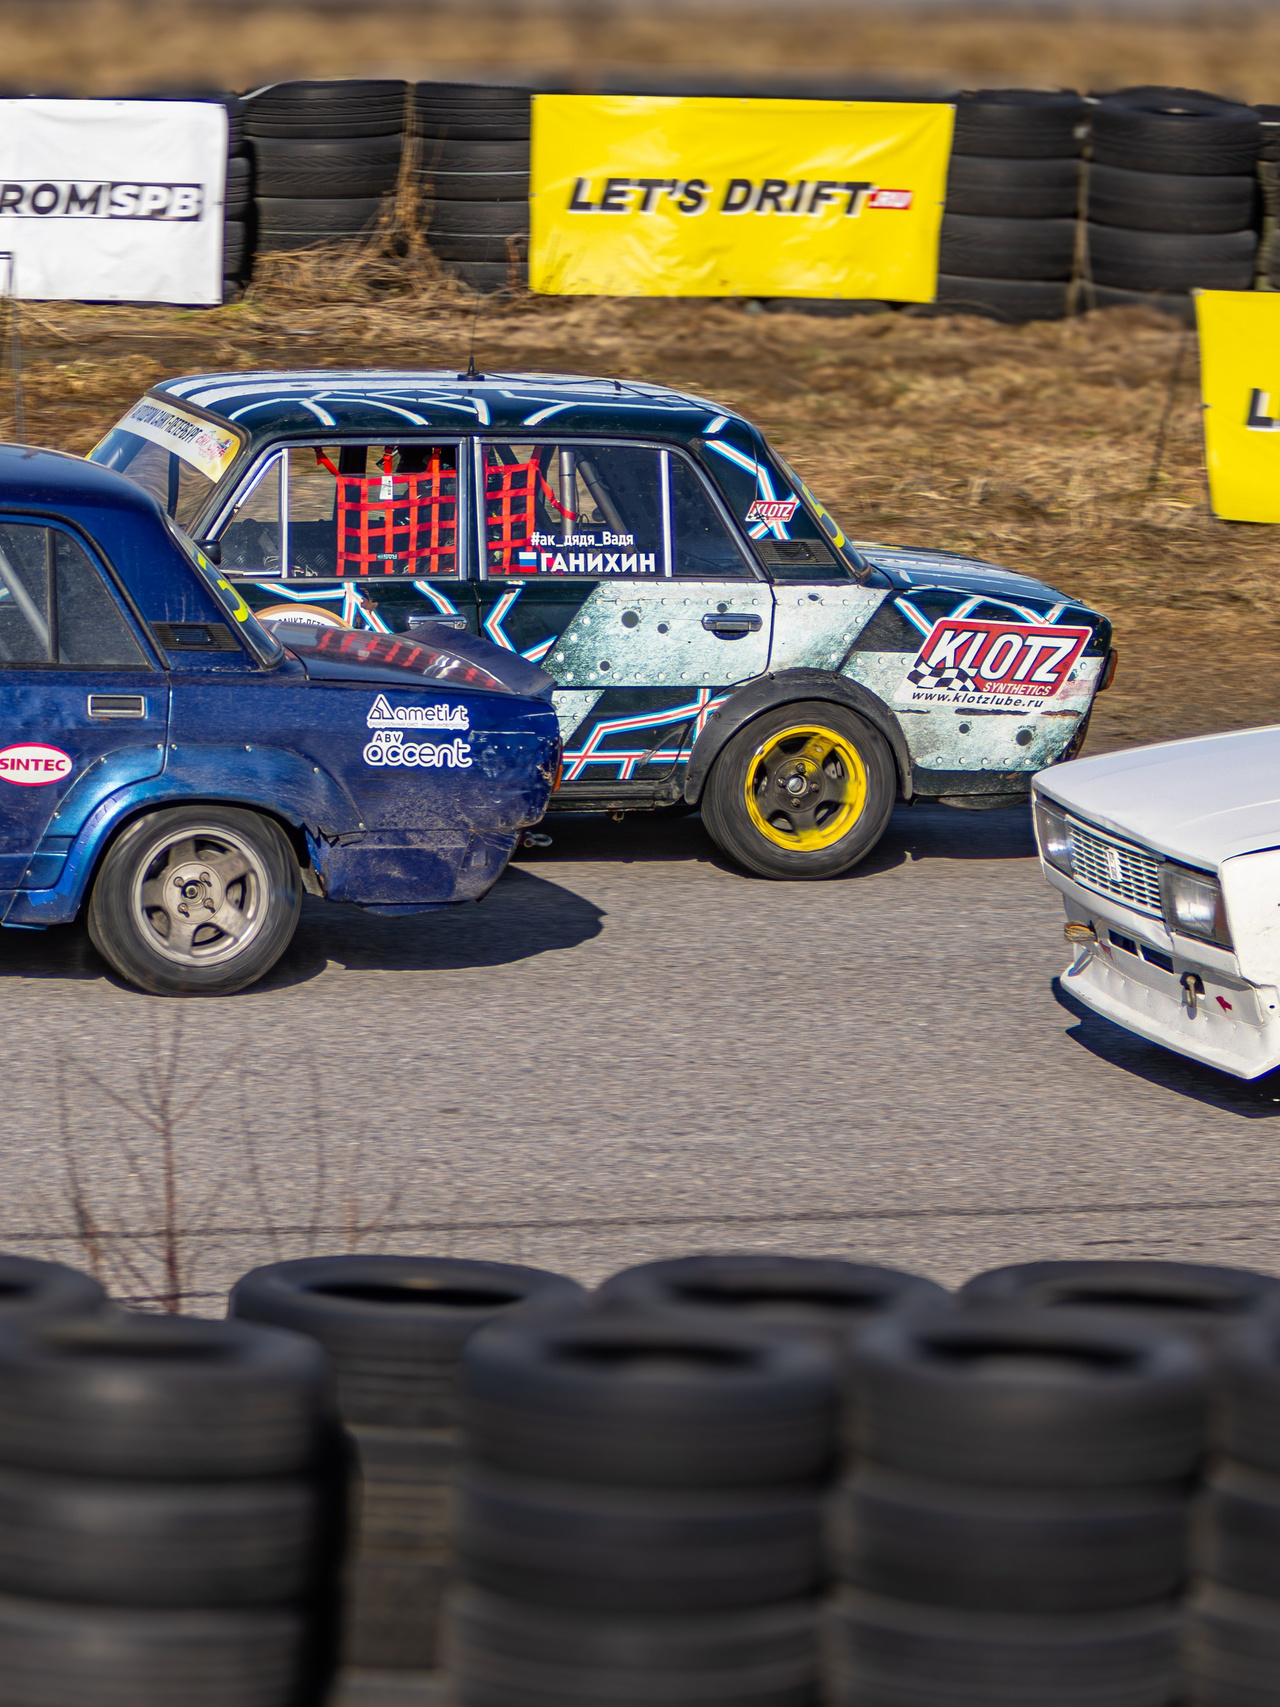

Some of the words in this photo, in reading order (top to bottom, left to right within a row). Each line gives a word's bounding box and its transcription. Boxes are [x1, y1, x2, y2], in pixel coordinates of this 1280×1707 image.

[567, 177, 708, 215] LET'S
[753, 503, 794, 517] KLOTZ
[531, 531, 634, 547] #ак_дядя_Вадя
[540, 552, 656, 573] ГАНИХИН
[926, 628, 1079, 683] KLOTZ
[983, 682, 1052, 696] SYNTHETICS
[911, 690, 1044, 708] www.klotzlube.ru
[396, 705, 468, 721] ametist
[375, 733, 401, 743] ABV
[366, 741, 471, 764] accent
